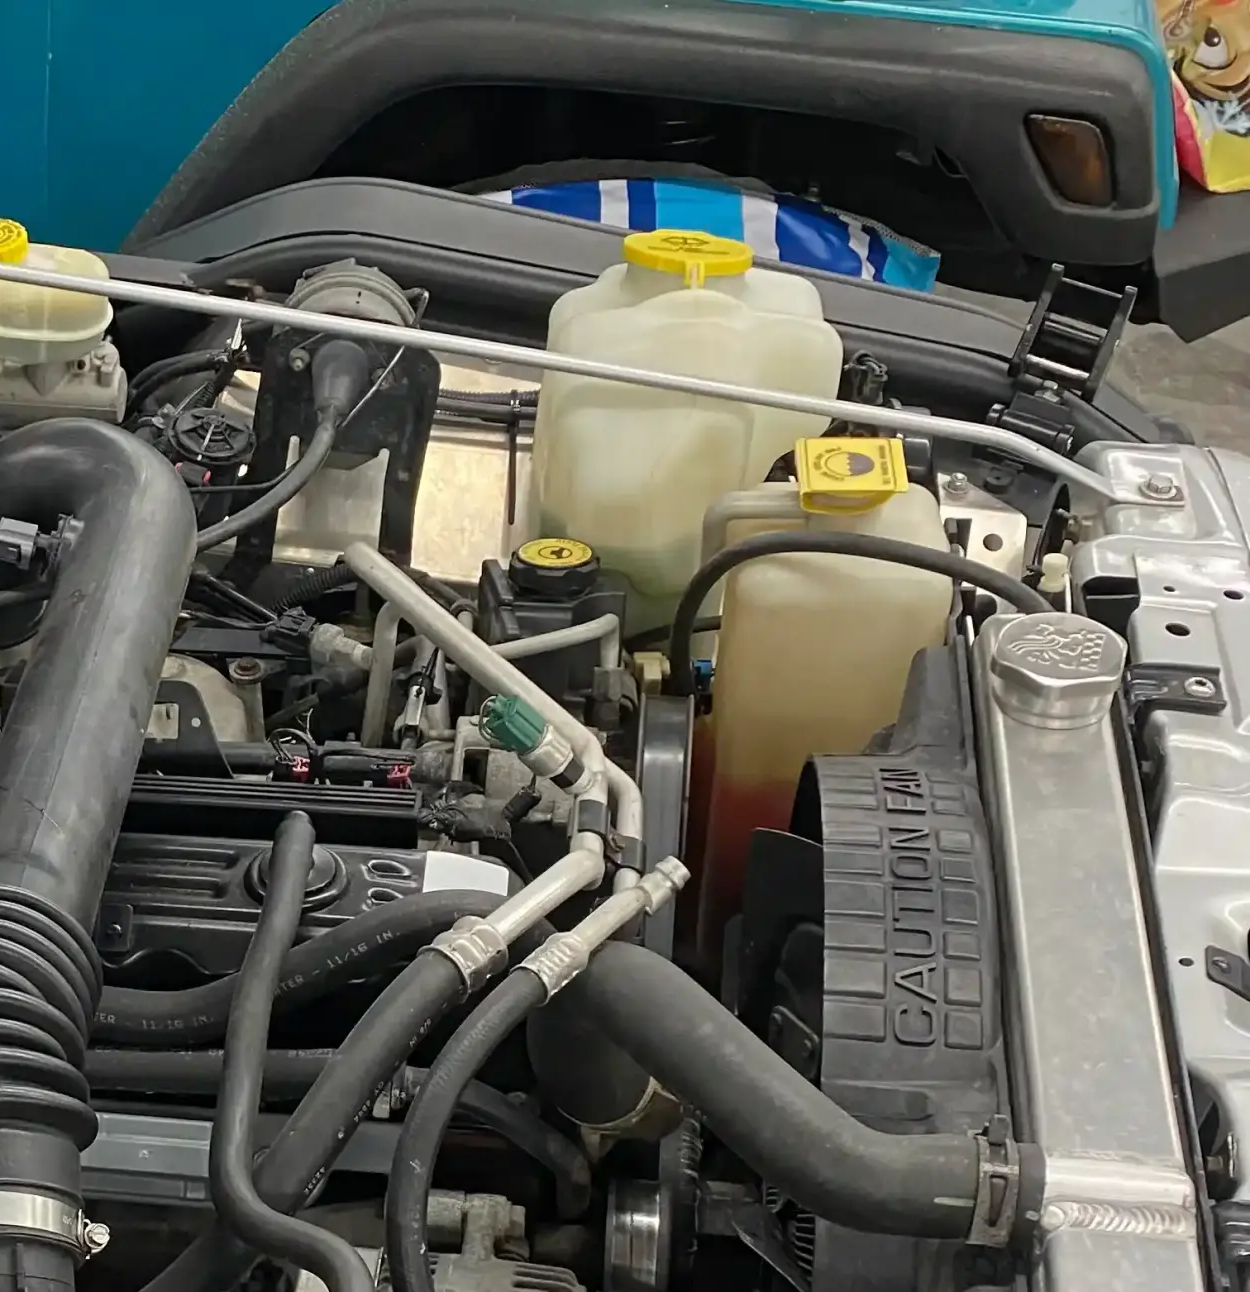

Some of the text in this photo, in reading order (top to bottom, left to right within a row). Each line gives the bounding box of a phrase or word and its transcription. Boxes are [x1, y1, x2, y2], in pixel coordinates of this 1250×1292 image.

[326, 942, 368, 969] 11/16
[879, 768, 938, 1047] CAUTION FAN
